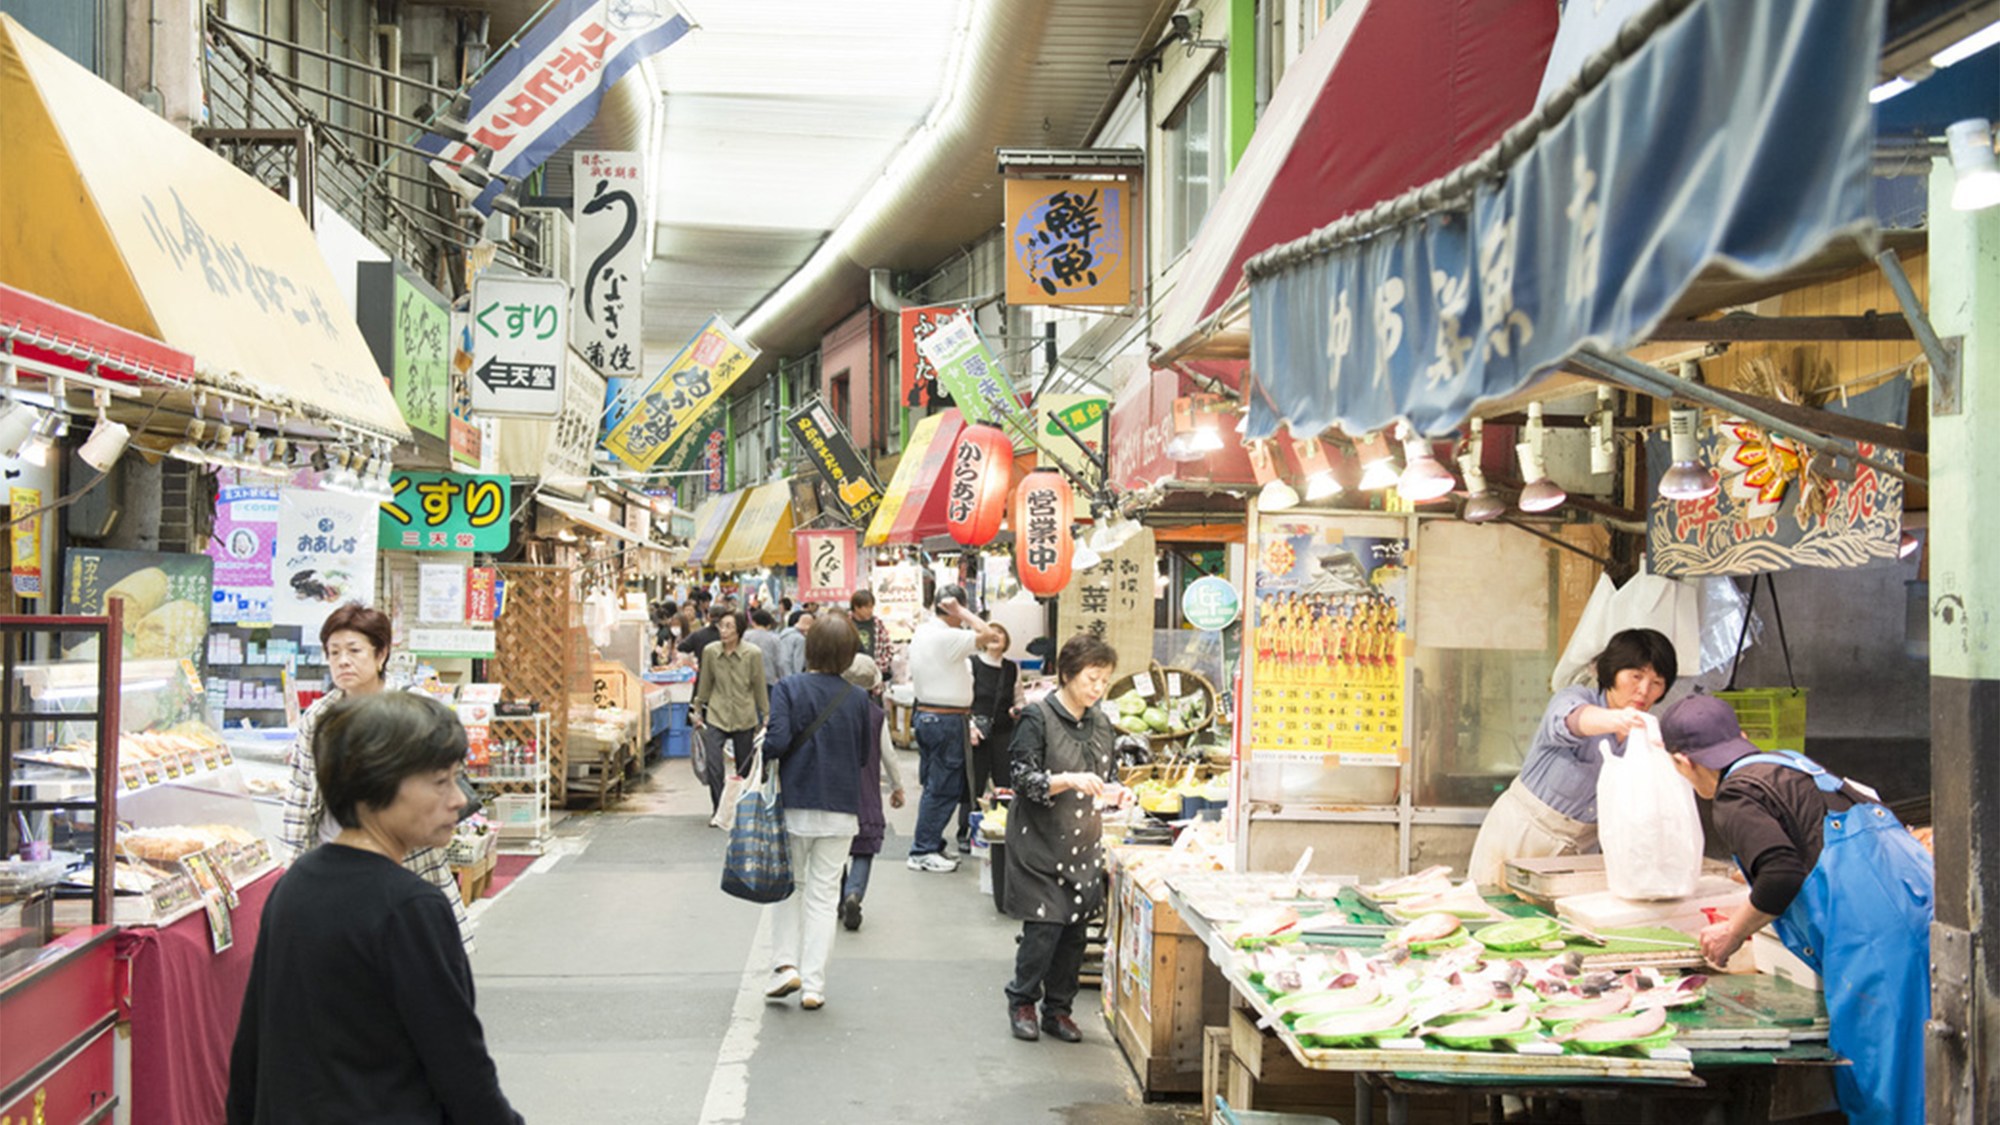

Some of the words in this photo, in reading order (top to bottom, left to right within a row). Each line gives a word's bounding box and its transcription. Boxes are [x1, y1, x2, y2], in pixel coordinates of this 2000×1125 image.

[582, 179, 638, 340] うなぎ
[476, 301, 558, 340] くすり
[488, 364, 552, 387] 三天堂
[379, 476, 506, 529] くすり
[950, 441, 982, 522] からあげ
[297, 533, 357, 555] おあしす
[401, 530, 476, 548] 三天堂
[1028, 489, 1058, 572] 営業中
[813, 540, 841, 588] うなぎ
